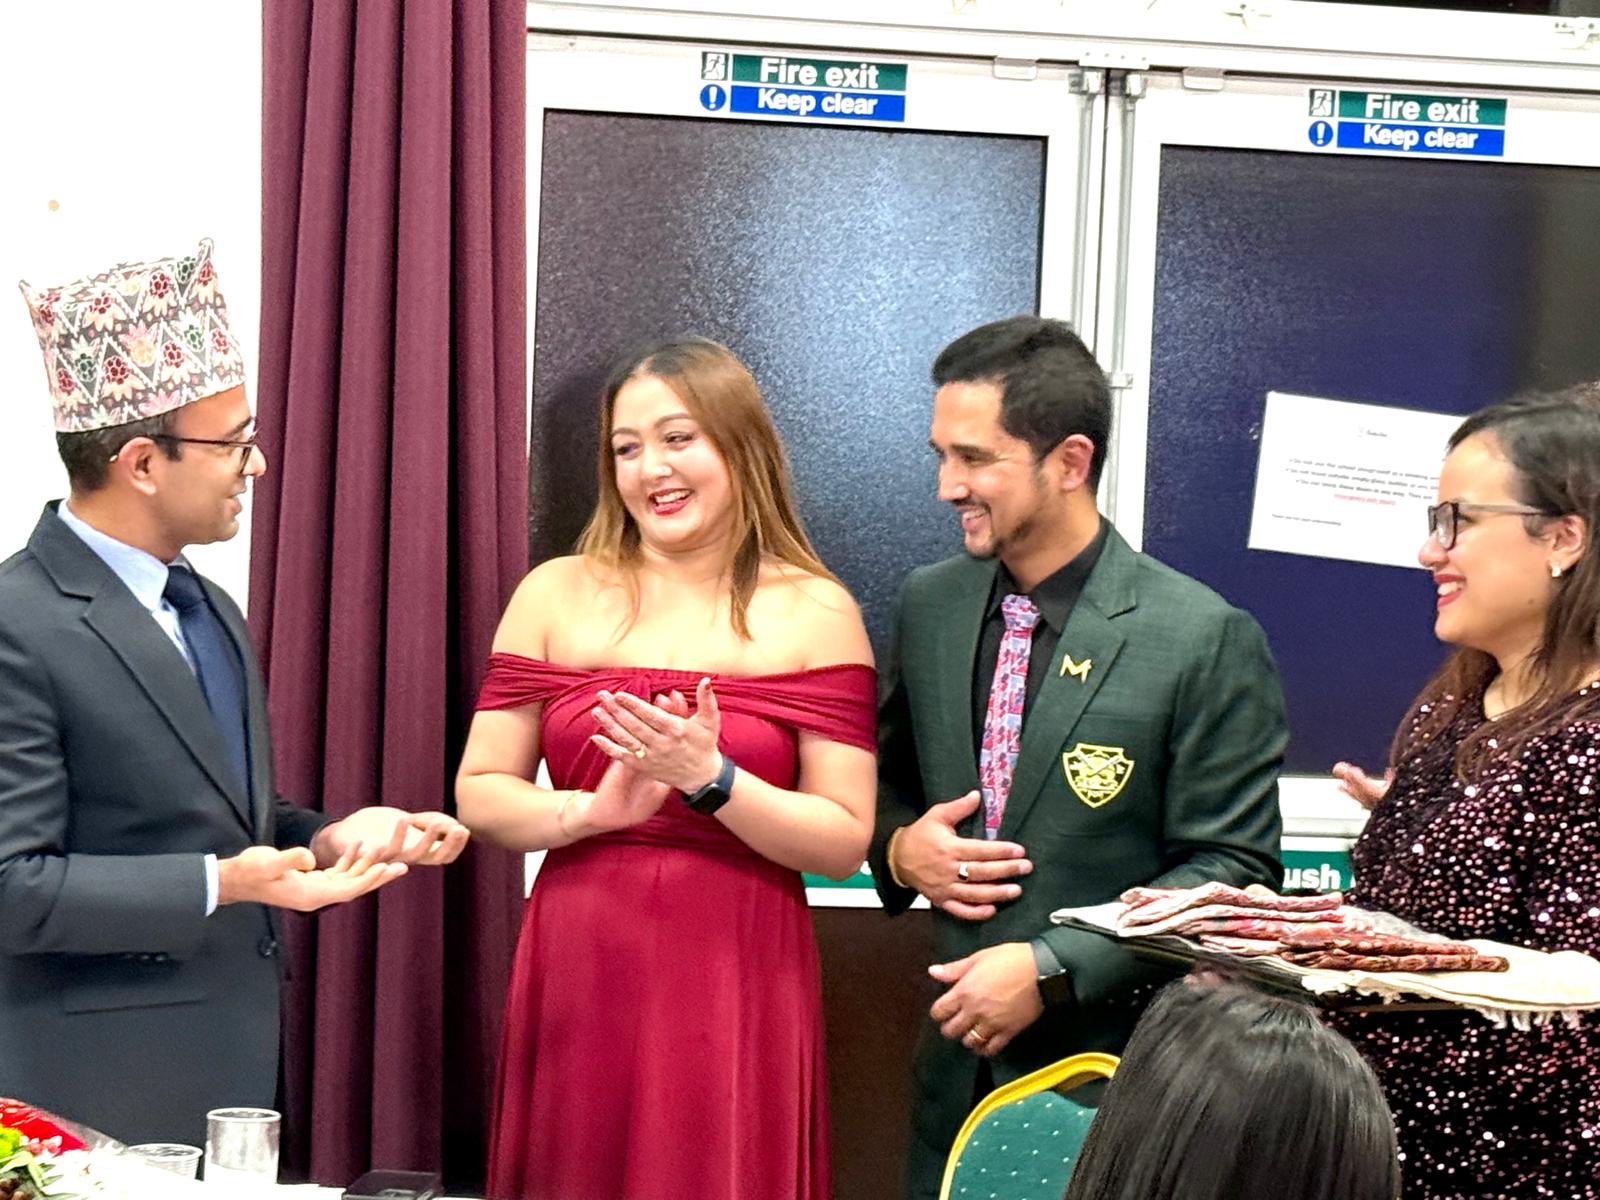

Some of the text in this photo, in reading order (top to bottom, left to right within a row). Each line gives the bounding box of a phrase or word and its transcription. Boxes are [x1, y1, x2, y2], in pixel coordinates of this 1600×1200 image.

[760, 57, 880, 89] Fire exit
[758, 88, 879, 116] Keep clear
[1365, 94, 1480, 123] Fire exit
[1363, 124, 1479, 151] Keep clear
[1282, 863, 1341, 890] ush
